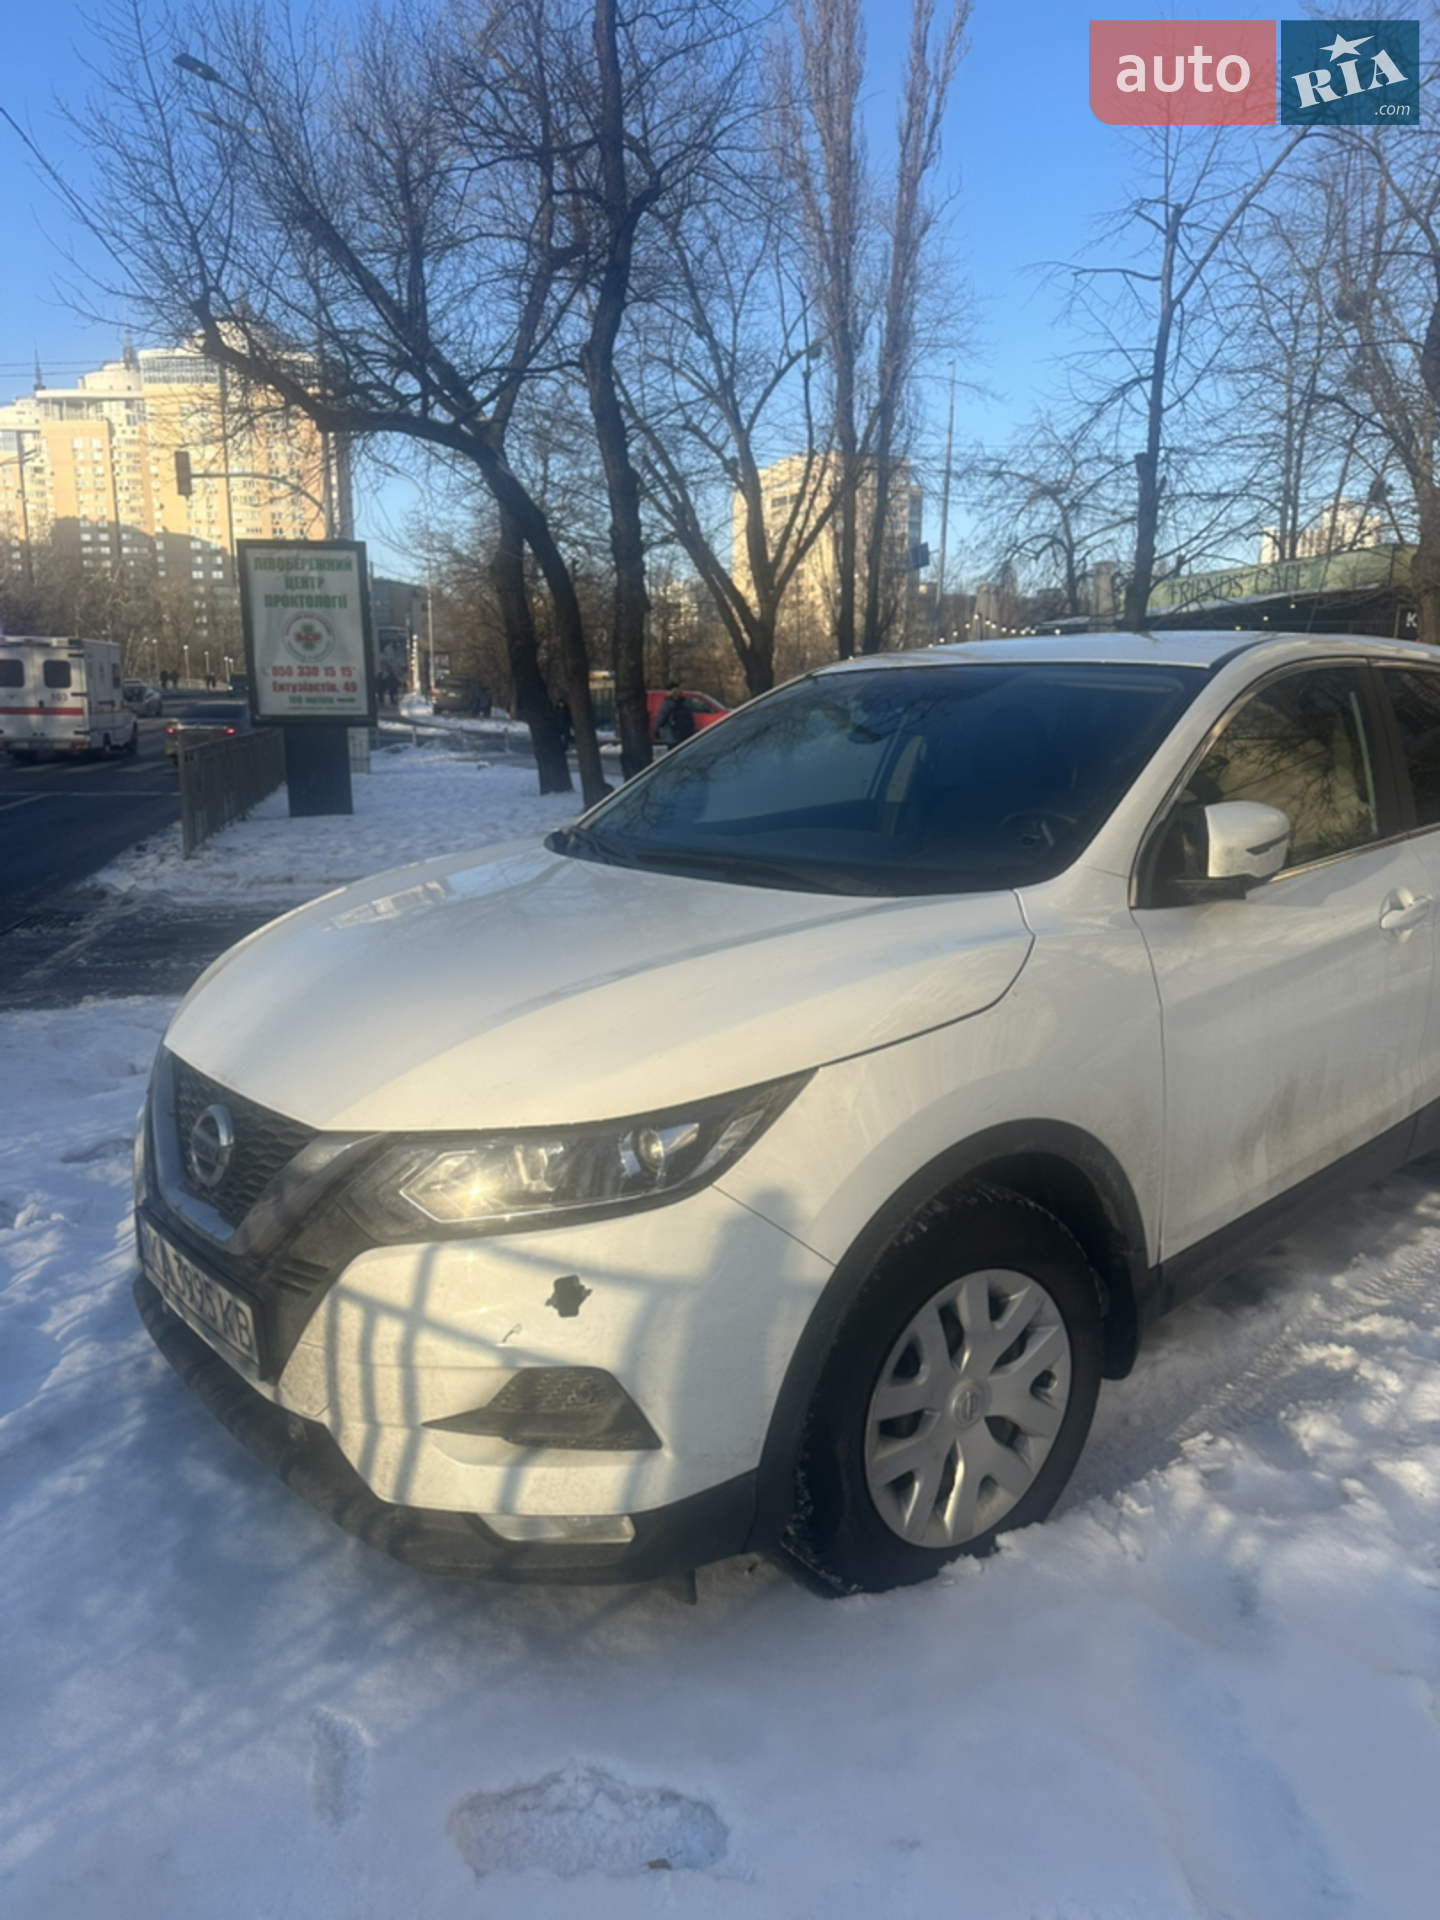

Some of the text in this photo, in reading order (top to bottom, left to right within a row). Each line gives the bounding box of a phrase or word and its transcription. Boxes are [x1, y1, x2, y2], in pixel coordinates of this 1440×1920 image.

[255, 557, 352, 571] ЛІВОБЕРЕЖНИЙ
[286, 577, 324, 591] ЦЕНТР
[265, 595, 347, 608] ПРОКТОЛОГІЇ
[272, 666, 293, 676] 050
[324, 667, 336, 676] 15
